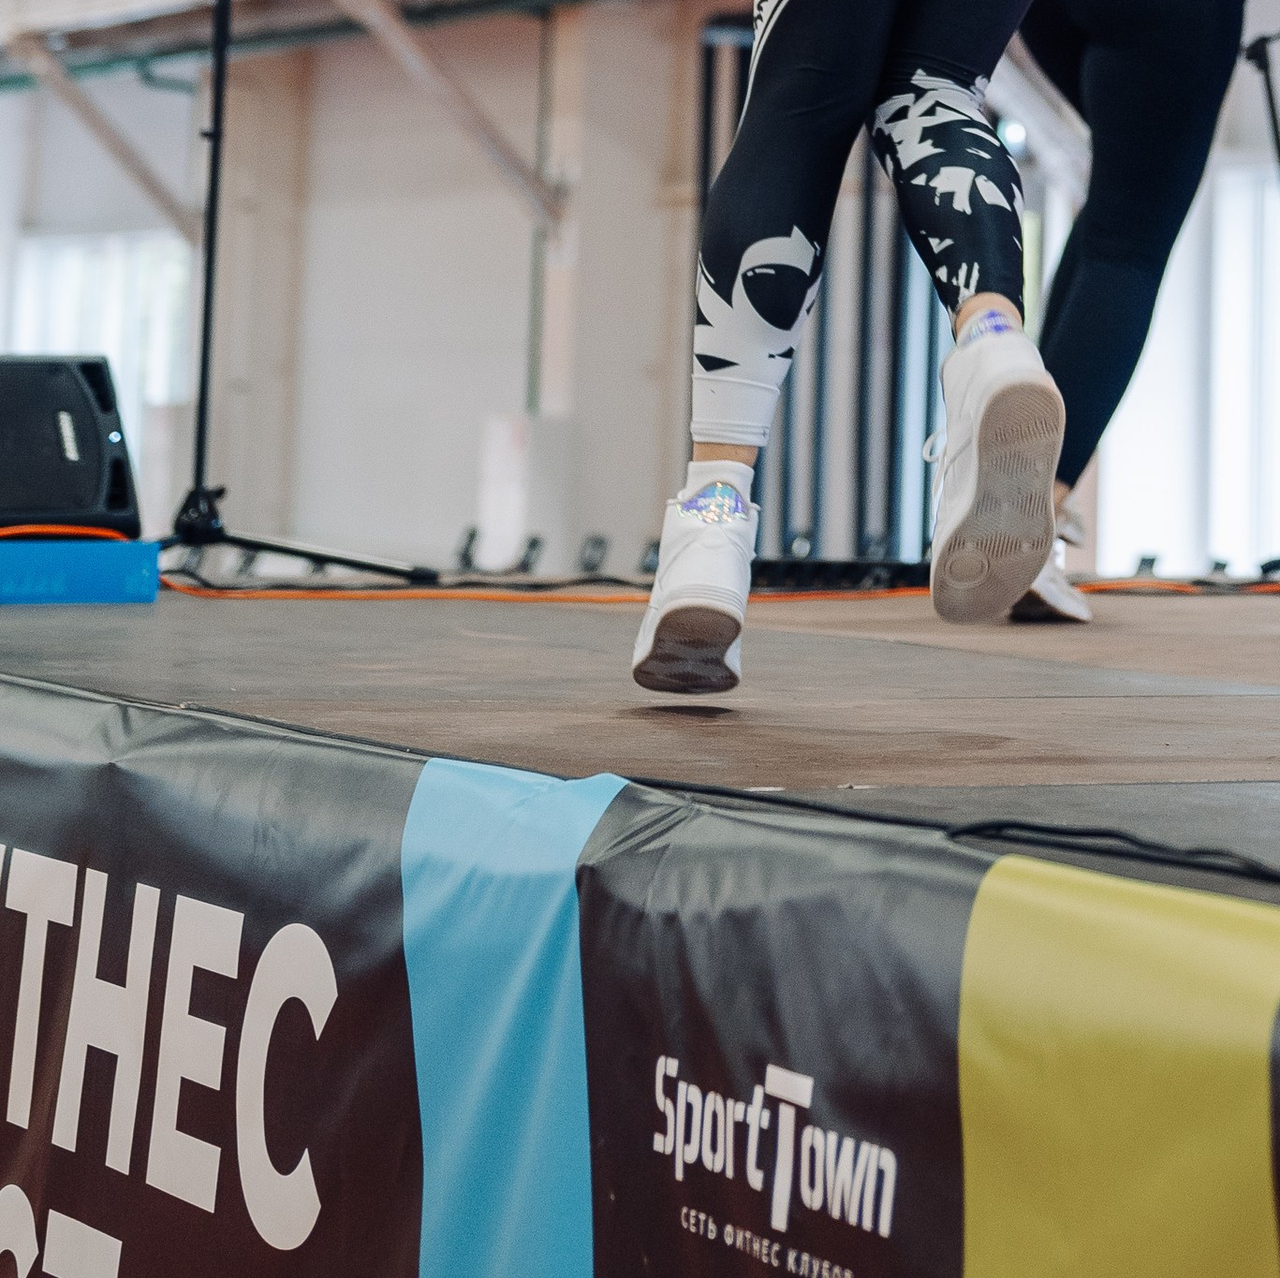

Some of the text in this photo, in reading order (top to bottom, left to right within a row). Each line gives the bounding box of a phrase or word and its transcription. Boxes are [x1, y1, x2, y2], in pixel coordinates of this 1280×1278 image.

[0, 847, 338, 1250] ТНЕС
[681, 1206, 718, 1240] СЕТЬ
[724, 1224, 780, 1267] ФИТНЕС
